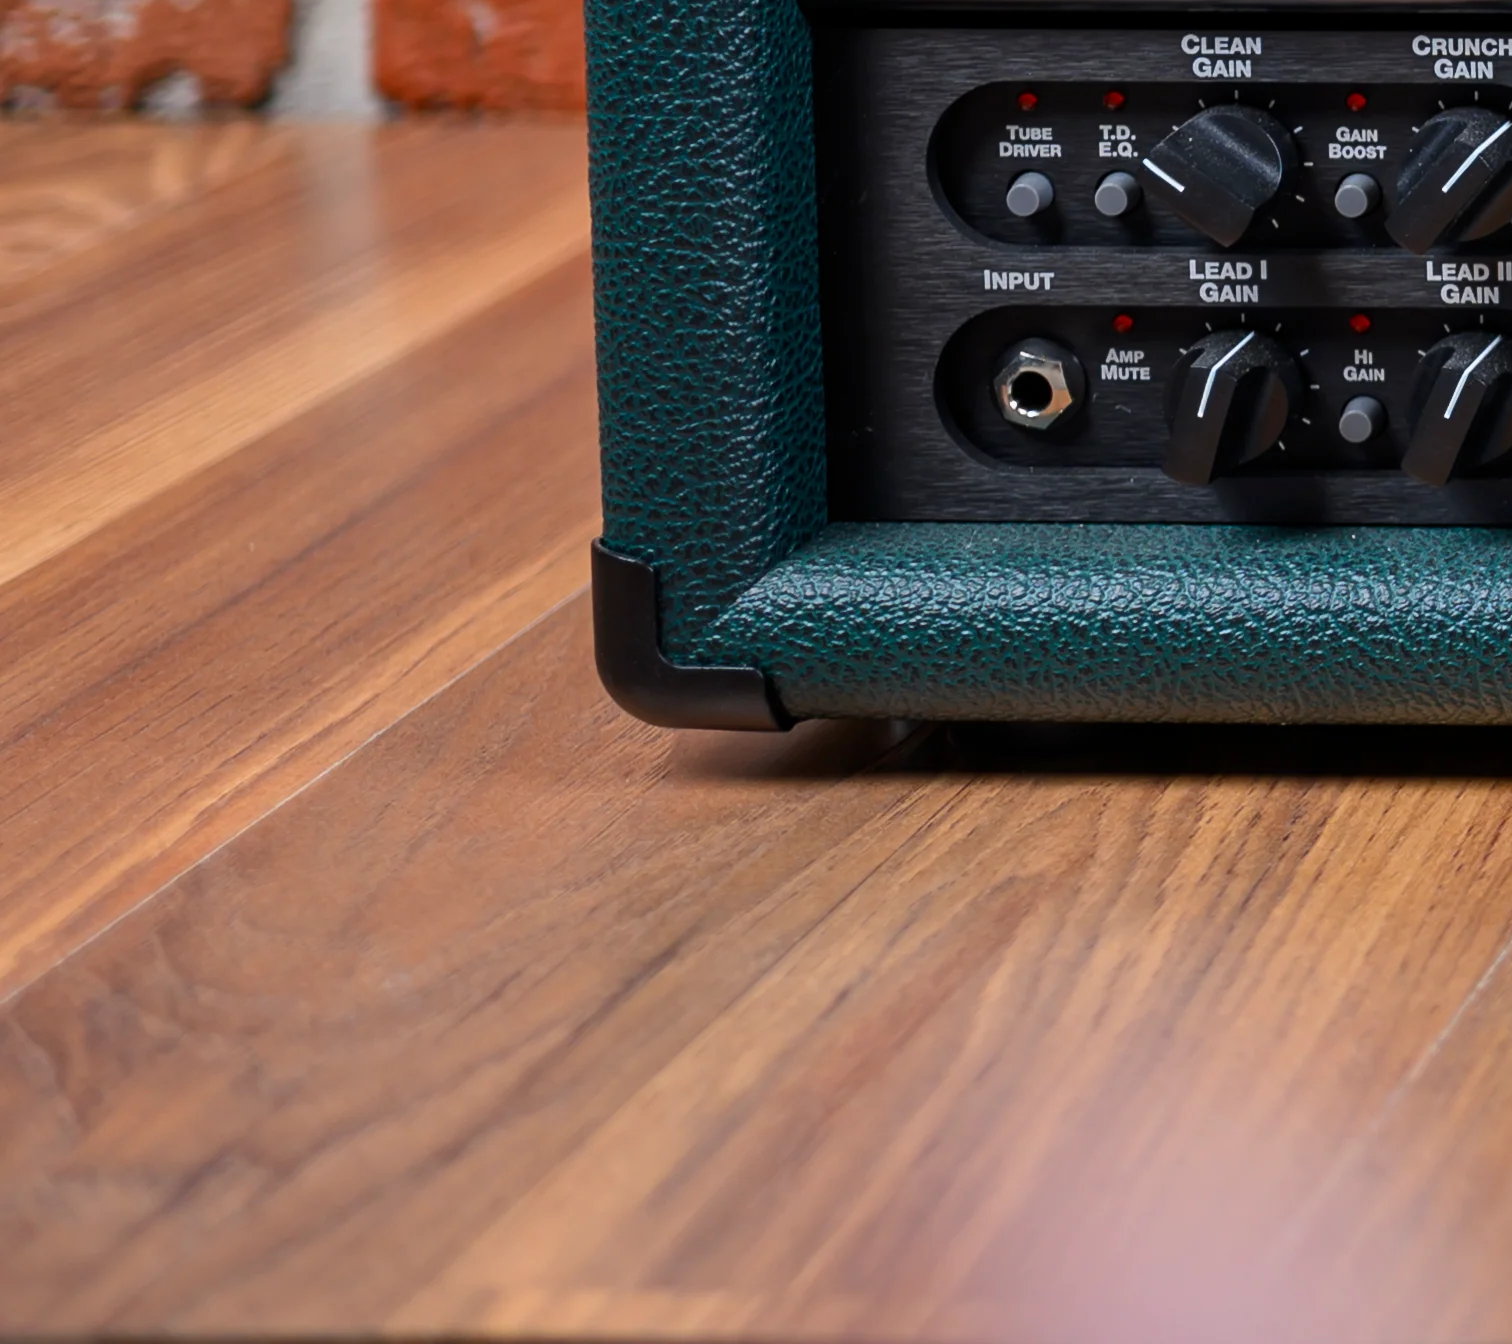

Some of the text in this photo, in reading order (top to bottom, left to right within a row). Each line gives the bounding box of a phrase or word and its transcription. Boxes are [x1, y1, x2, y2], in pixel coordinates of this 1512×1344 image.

[1180, 33, 1262, 55] CLEAN
[1192, 56, 1252, 78] GAIN
[1433, 58, 1494, 80] GAIN
[1006, 125, 1053, 141] TUBE
[1099, 124, 1137, 141] T.D.
[1335, 126, 1379, 143] GAIN
[999, 141, 1062, 158] DRIVER
[1098, 141, 1139, 158] E.Q.
[1328, 143, 1387, 160] BOOST
[1188, 258, 1253, 280] LEAD
[1426, 260, 1490, 282] LEAD
[983, 269, 1055, 291] INPUT
[1199, 281, 1259, 303] GAIN
[1440, 283, 1499, 305] GAIN
[1105, 347, 1145, 364] AMP
[1354, 349, 1373, 365] HI
[1100, 364, 1151, 381] MUTE
[1342, 365, 1386, 382] GAIN
